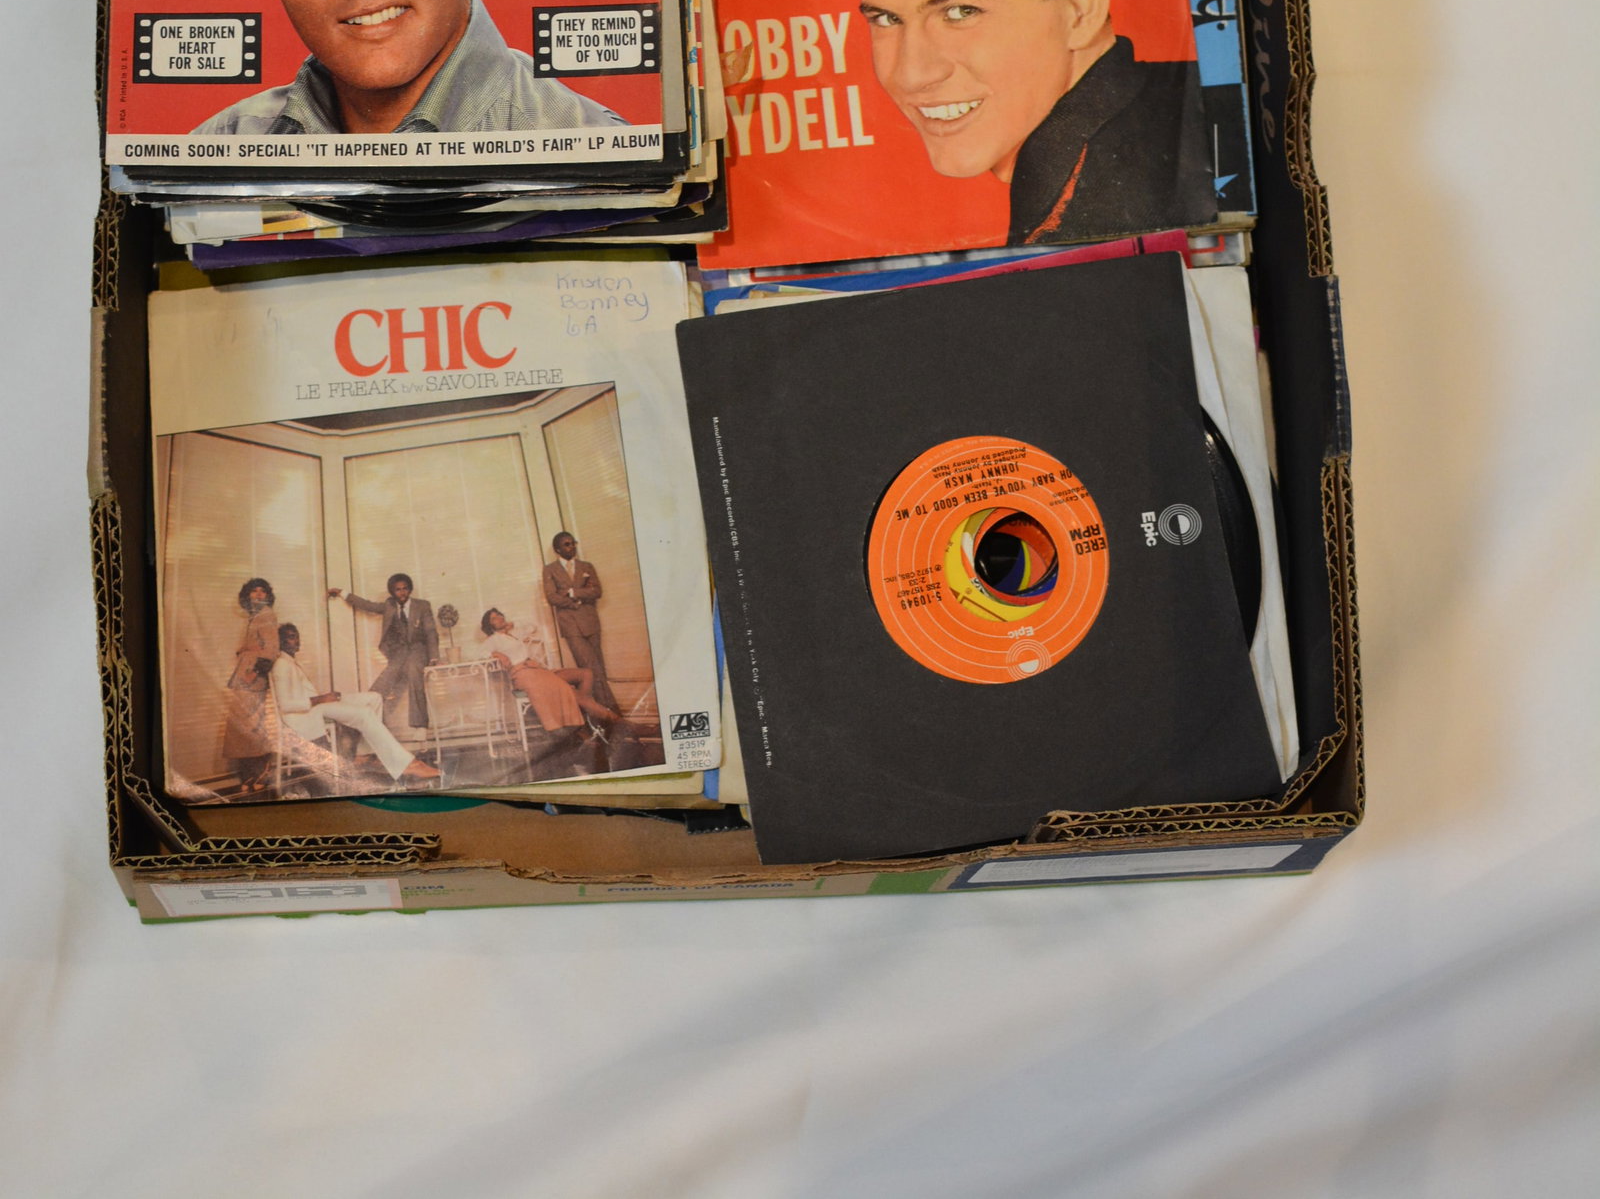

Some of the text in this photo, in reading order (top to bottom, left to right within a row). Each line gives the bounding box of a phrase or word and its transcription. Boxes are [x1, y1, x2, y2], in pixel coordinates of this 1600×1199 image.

[556, 17, 636, 32] THEY REMIND
[160, 26, 235, 39] ONE BROKEN
[178, 42, 216, 54] HEART
[556, 33, 637, 48] ME TOO MUCH
[169, 57, 226, 70] FOR SALE
[576, 49, 619, 63] OF YOU
[723, 85, 875, 158] YDELL
[125, 144, 180, 158] COMING
[188, 144, 230, 157] SOON!
[239, 144, 300, 157] SPECIAL!
[335, 143, 408, 156] HAPPENED
[416, 143, 432, 156] AT
[439, 142, 466, 155] THE
[472, 139, 535, 154] WORLD'S
[543, 137, 582, 152] FAIR"
[588, 136, 605, 150] LP
[612, 134, 660, 149] ALBUM
[334, 301, 517, 378] CHIC
[295, 369, 563, 401] LE FREAK b/w SAVOIR FAIRE
[712, 416, 726, 466] Manufactured
[722, 478, 730, 495] Epic
[932, 446, 1026, 473] Produced by Johnny Nash
[933, 453, 1026, 479] Arranged by Johnny Nash
[945, 461, 1020, 489] JOHNNY NASH
[1032, 473, 1055, 487] BABY
[933, 497, 959, 512] GOOD
[964, 490, 988, 504] BEEN
[896, 508, 910, 521] ME
[915, 504, 928, 516] TO
[1069, 524, 1101, 542] RPM
[1140, 511, 1159, 547] Epic
[1075, 537, 1106, 556] EREO
[916, 568, 934, 577] 1972
[926, 582, 941, 591] ZSS
[901, 591, 943, 610] 5-10949
[1008, 625, 1035, 639] Epic
[691, 750, 712, 759] RPM
[678, 758, 712, 769] STEREO
